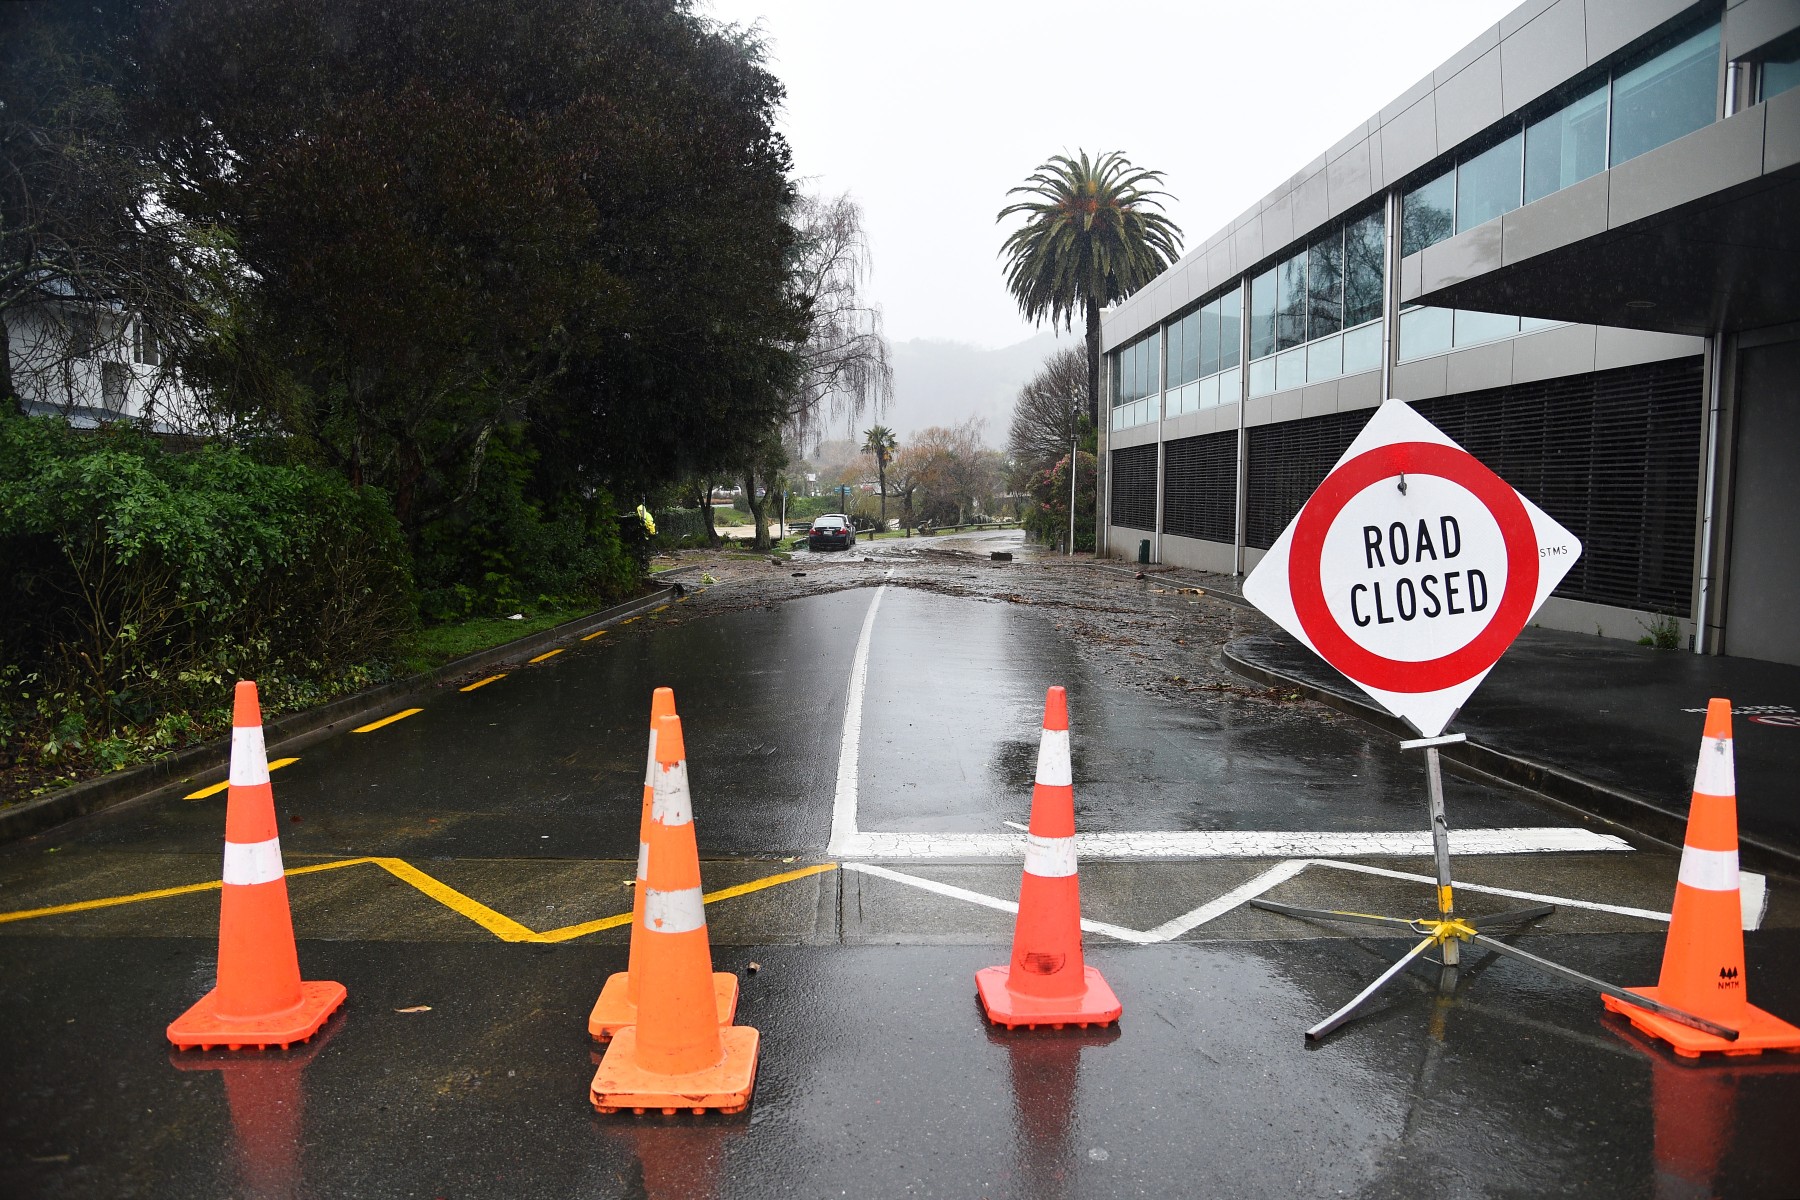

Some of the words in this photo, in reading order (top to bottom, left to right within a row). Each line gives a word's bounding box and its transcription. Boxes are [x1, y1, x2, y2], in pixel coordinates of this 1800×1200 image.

[1363, 515, 1461, 569] ROAD
[1539, 545, 1568, 558] STMS
[1350, 569, 1488, 627] CLOSED
[1717, 980, 1740, 990] NMTM
